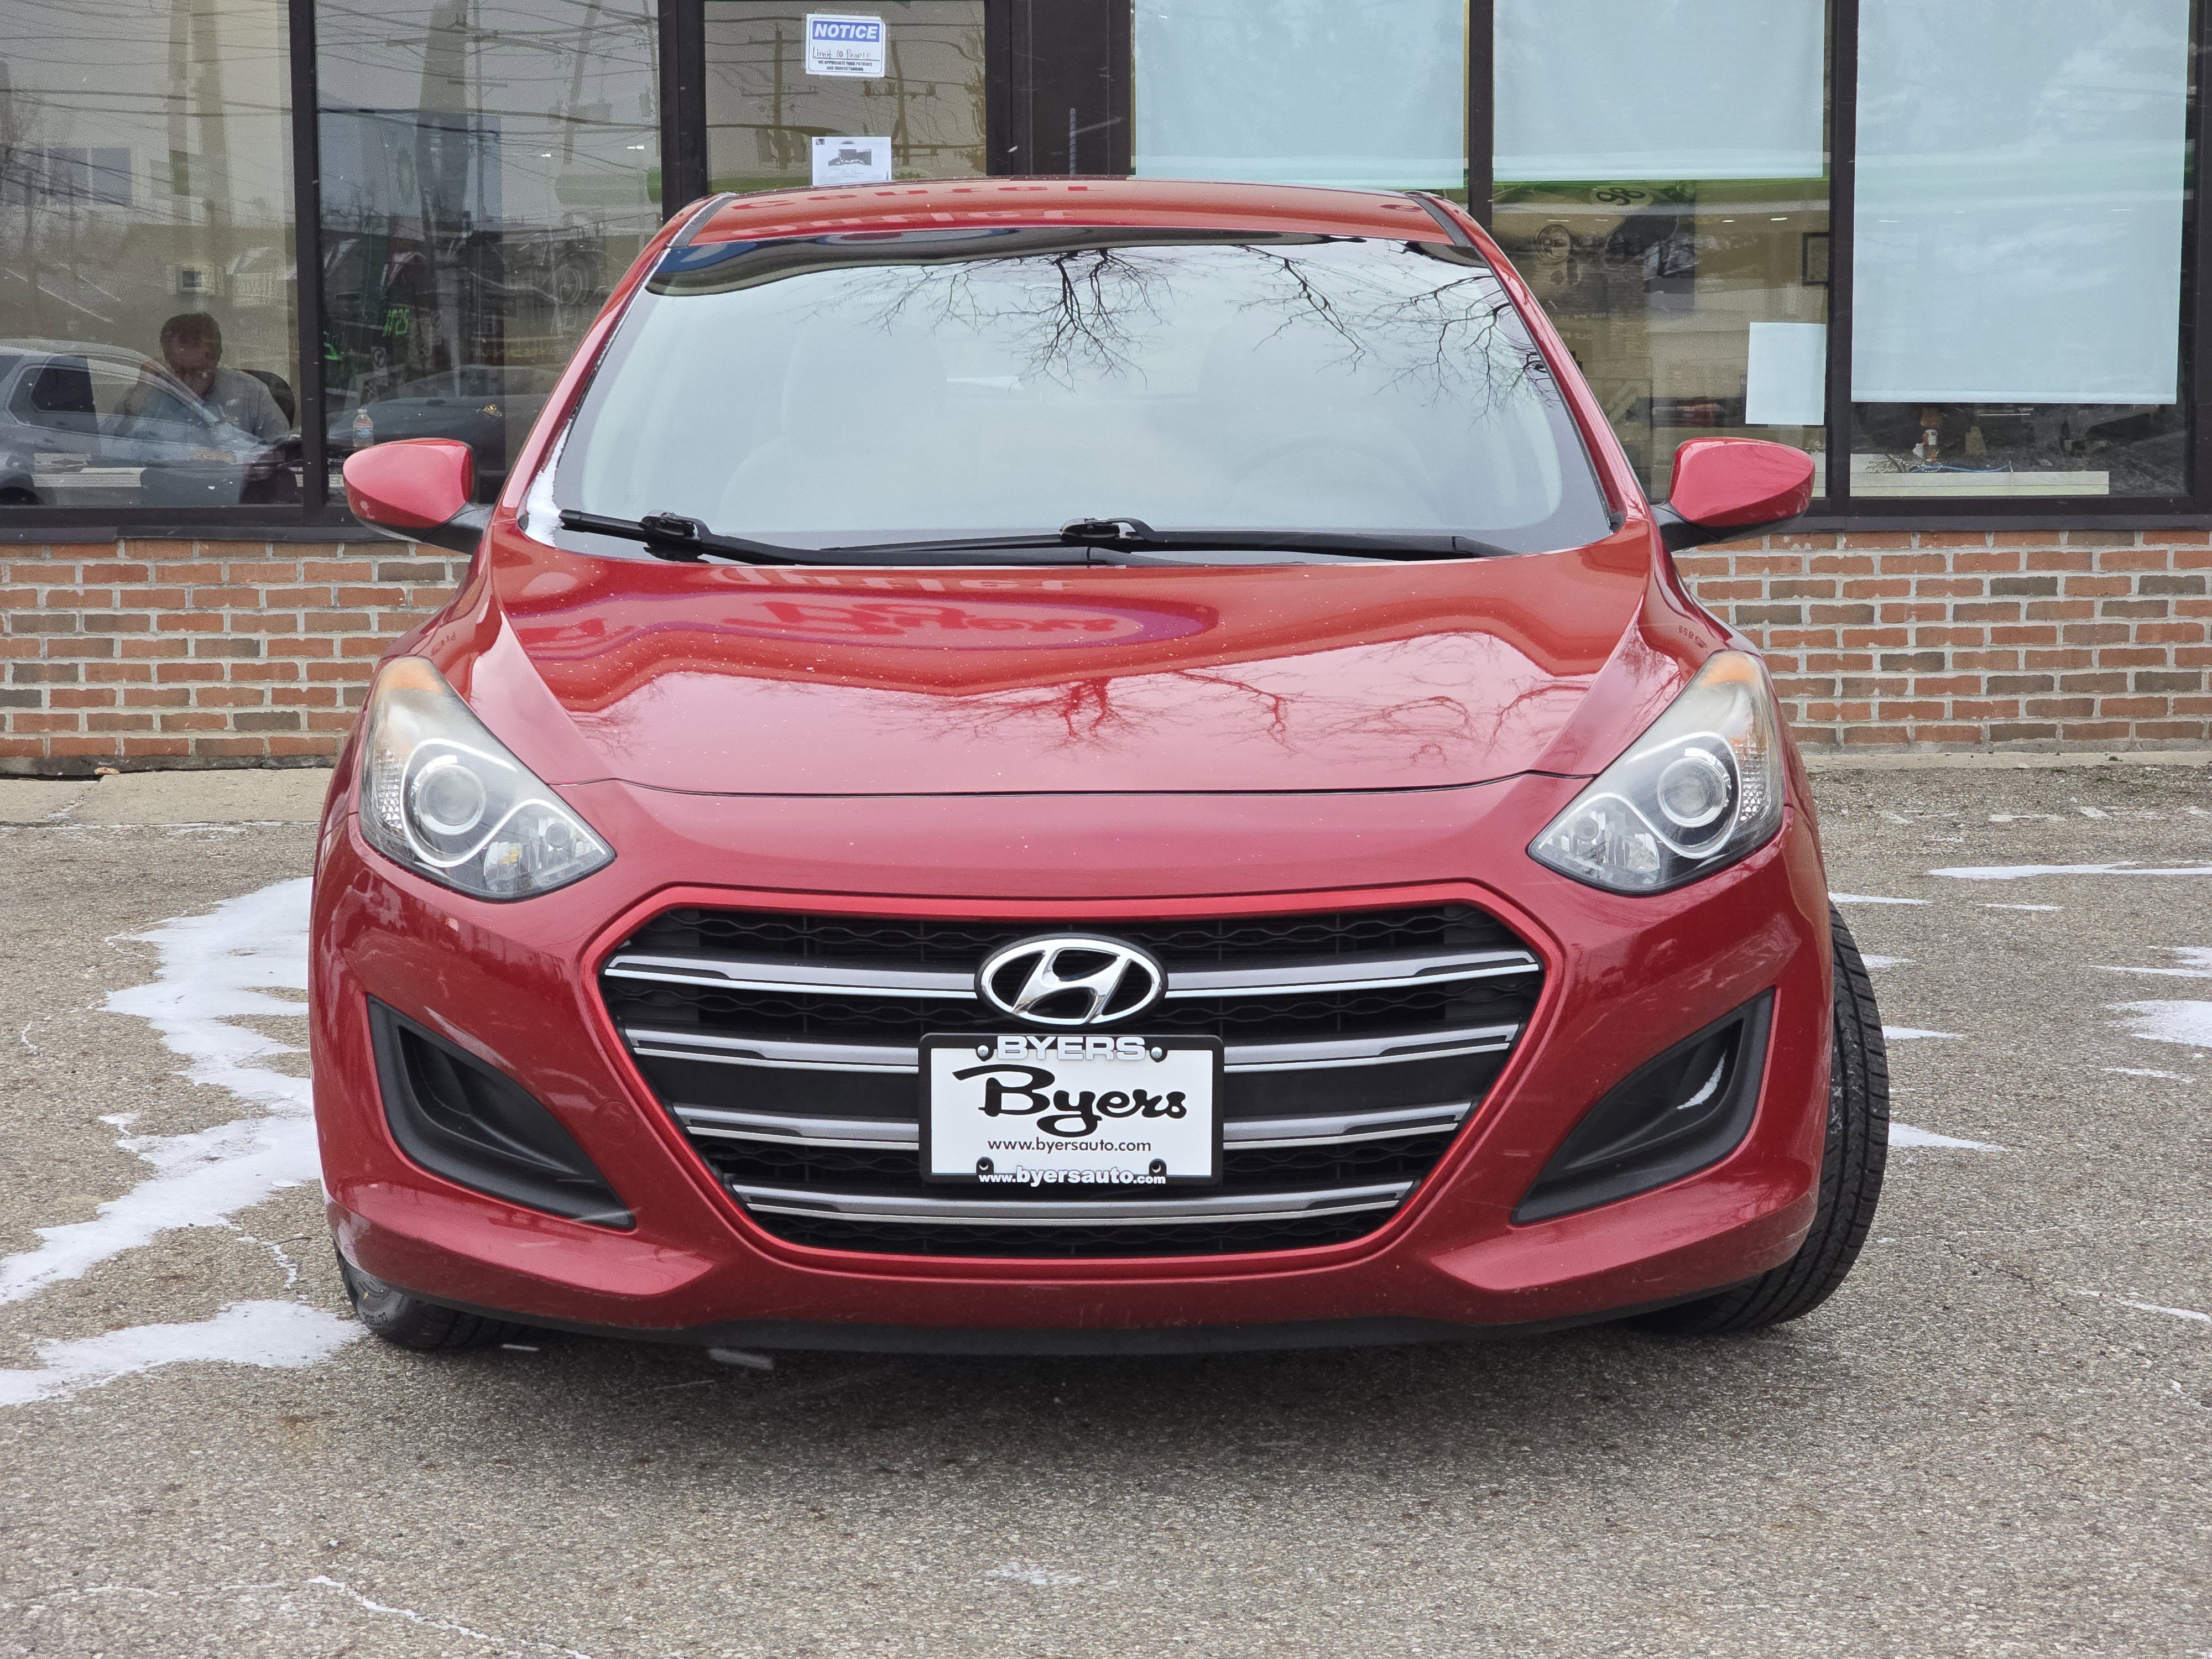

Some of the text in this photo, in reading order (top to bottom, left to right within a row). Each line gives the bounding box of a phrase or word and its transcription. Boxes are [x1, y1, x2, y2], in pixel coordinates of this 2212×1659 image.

[815, 23, 878, 39] NOTICE
[812, 46, 831, 59] Limit
[997, 1036, 1146, 1061] BYERS
[952, 1064, 1187, 1138] Byers
[988, 1137, 1152, 1154] www.byersauto.com
[978, 1165, 1166, 1187] www.byersauto.com
